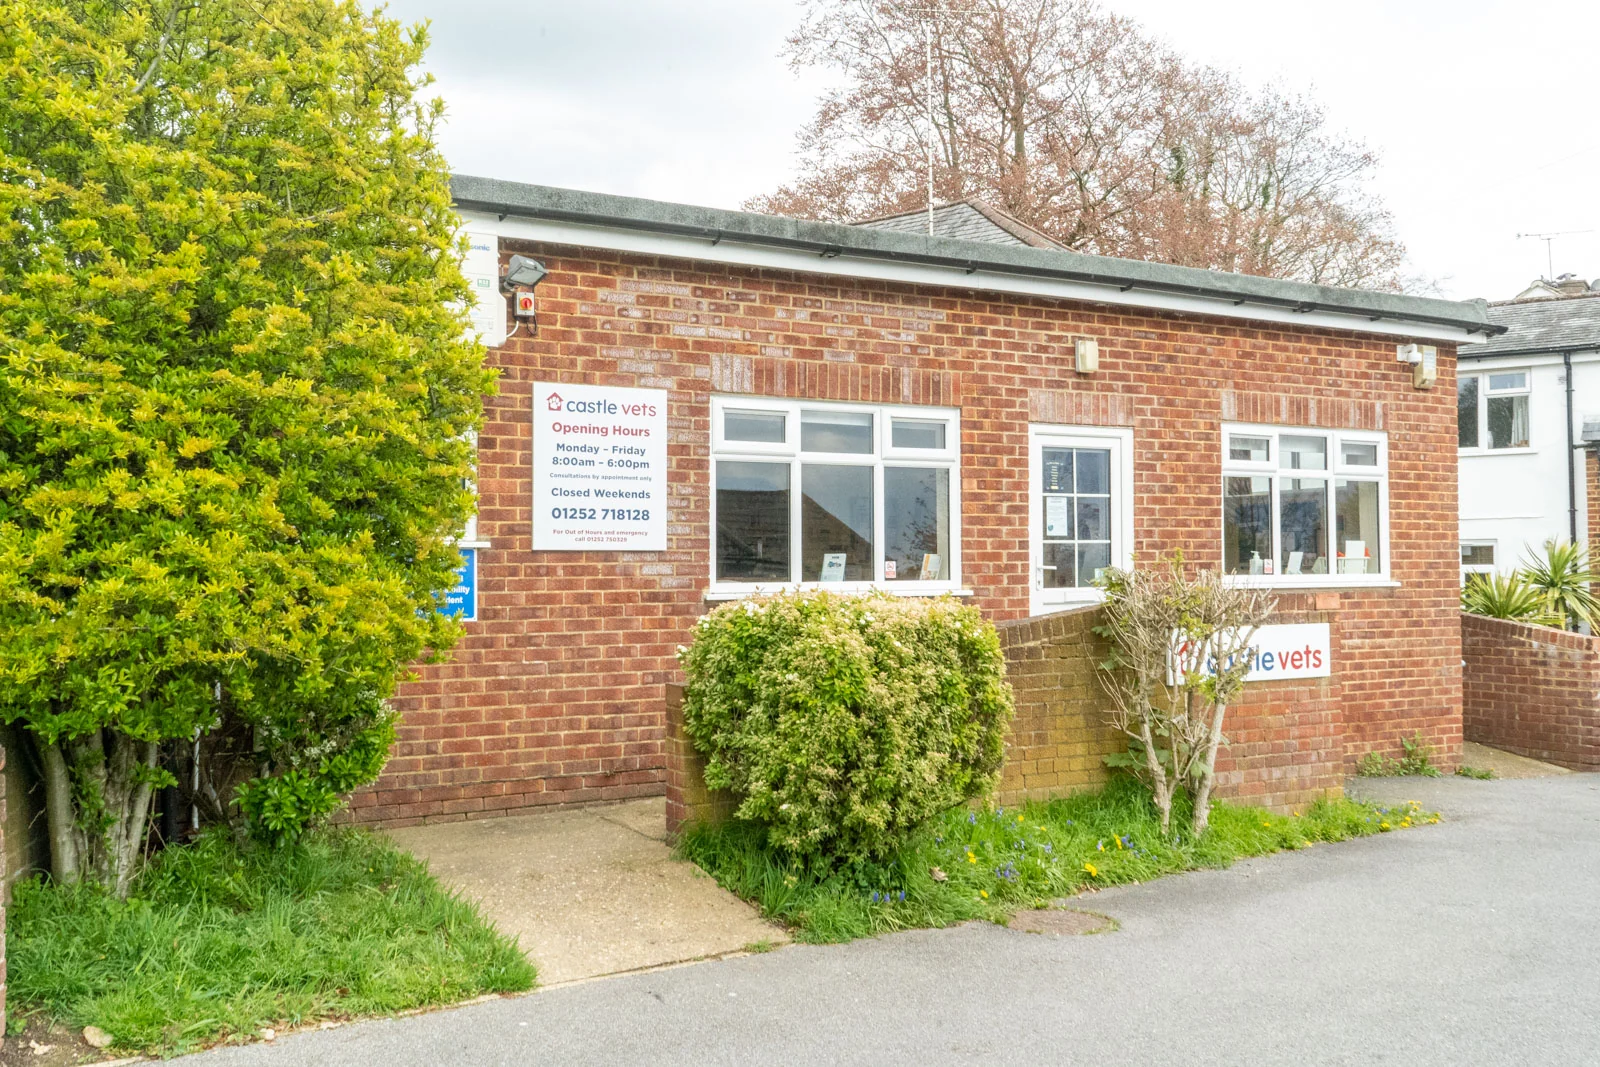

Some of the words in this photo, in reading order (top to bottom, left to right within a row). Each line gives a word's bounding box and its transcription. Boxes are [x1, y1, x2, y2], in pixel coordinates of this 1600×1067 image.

[566, 399, 618, 415] castle
[621, 402, 657, 417] vets
[552, 422, 609, 437] Opening
[612, 425, 651, 437] Hours
[556, 443, 600, 454] Monday
[612, 445, 646, 457] Friday
[552, 456, 596, 467] 8:00am
[607, 459, 650, 470] 6:00pm
[549, 472, 591, 480] Consultations
[551, 487, 590, 498] Closed
[593, 489, 651, 499] Weekends
[551, 507, 597, 520] 01252
[601, 508, 650, 521] 718128
[1278, 644, 1322, 671] vets
